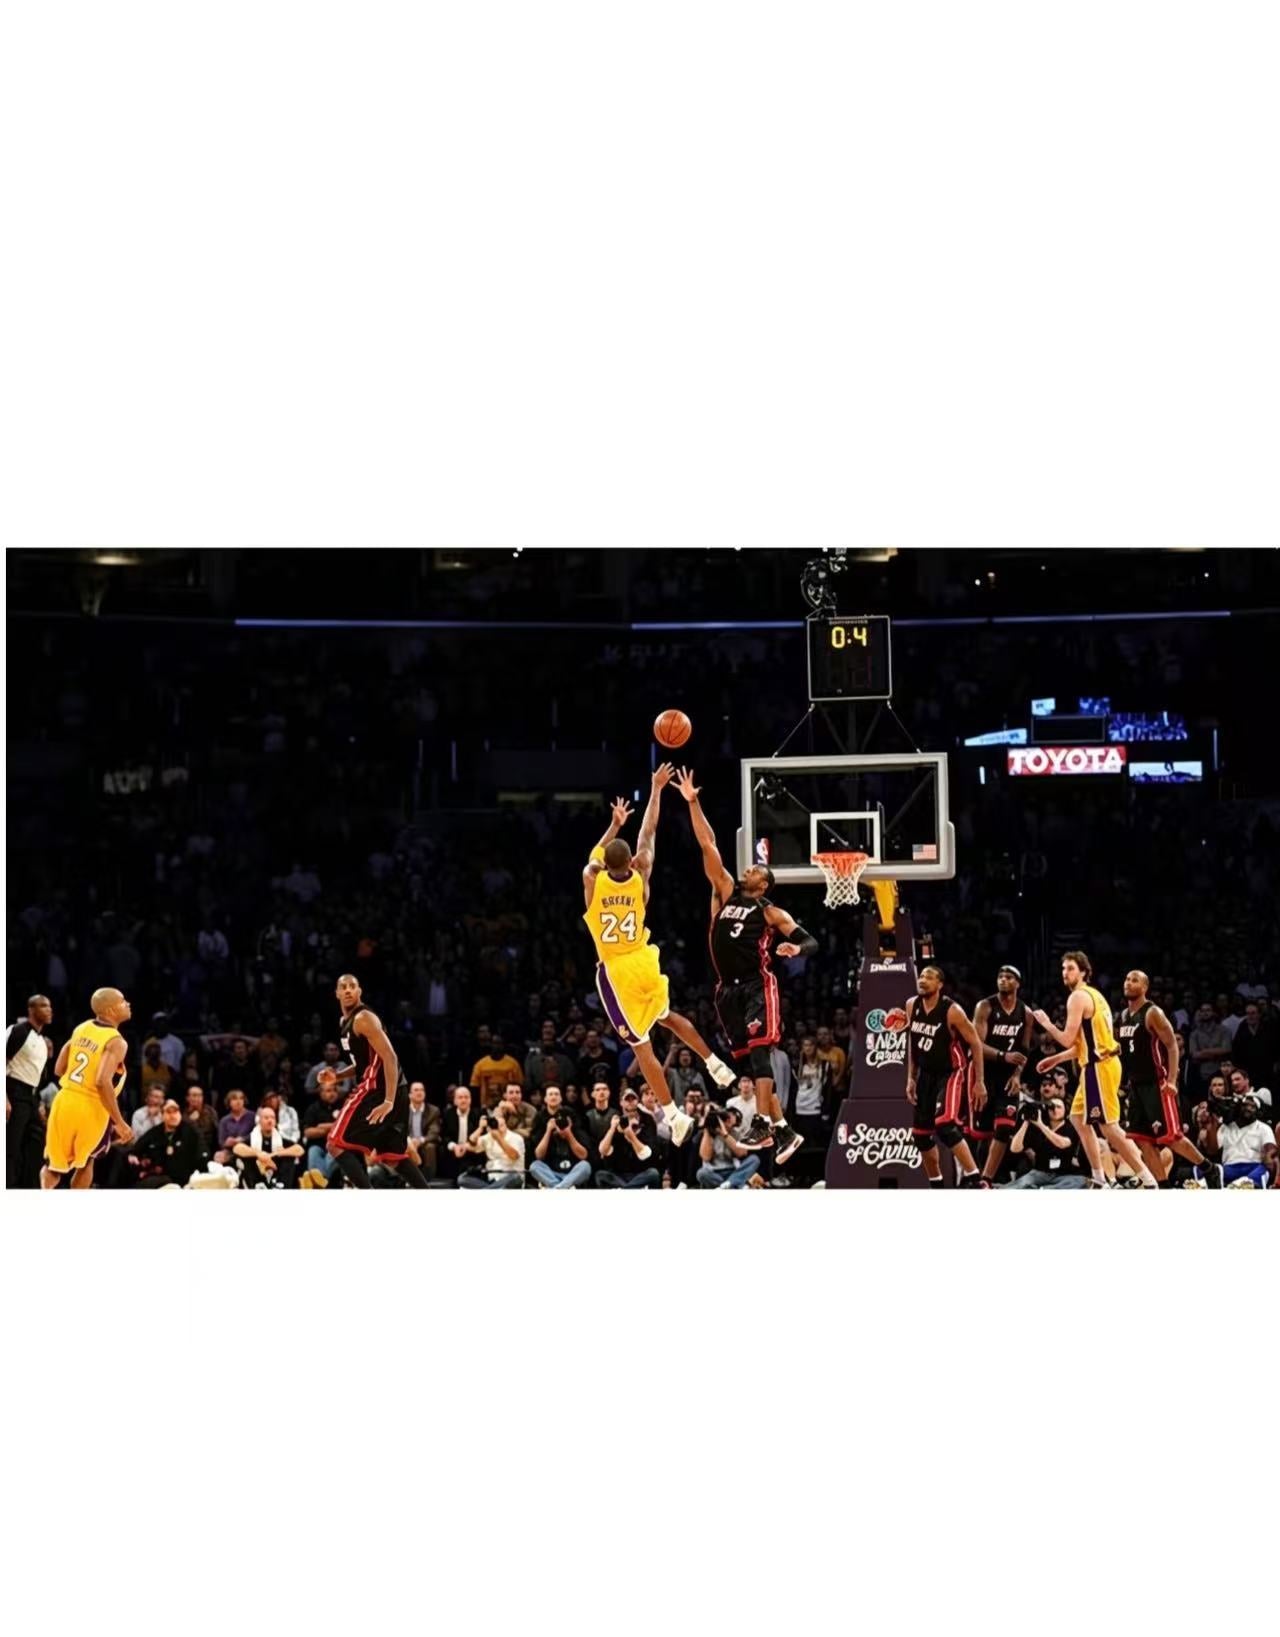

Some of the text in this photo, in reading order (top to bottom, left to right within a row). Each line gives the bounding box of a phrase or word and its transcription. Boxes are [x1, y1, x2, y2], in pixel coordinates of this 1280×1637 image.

[1008, 747, 1122, 775] TOYOTA
[600, 911, 637, 944] 24
[730, 922, 744, 938] 3
[875, 1031, 907, 1051] NBA
[69, 1051, 89, 1085] 2
[846, 1146, 864, 1165] of
